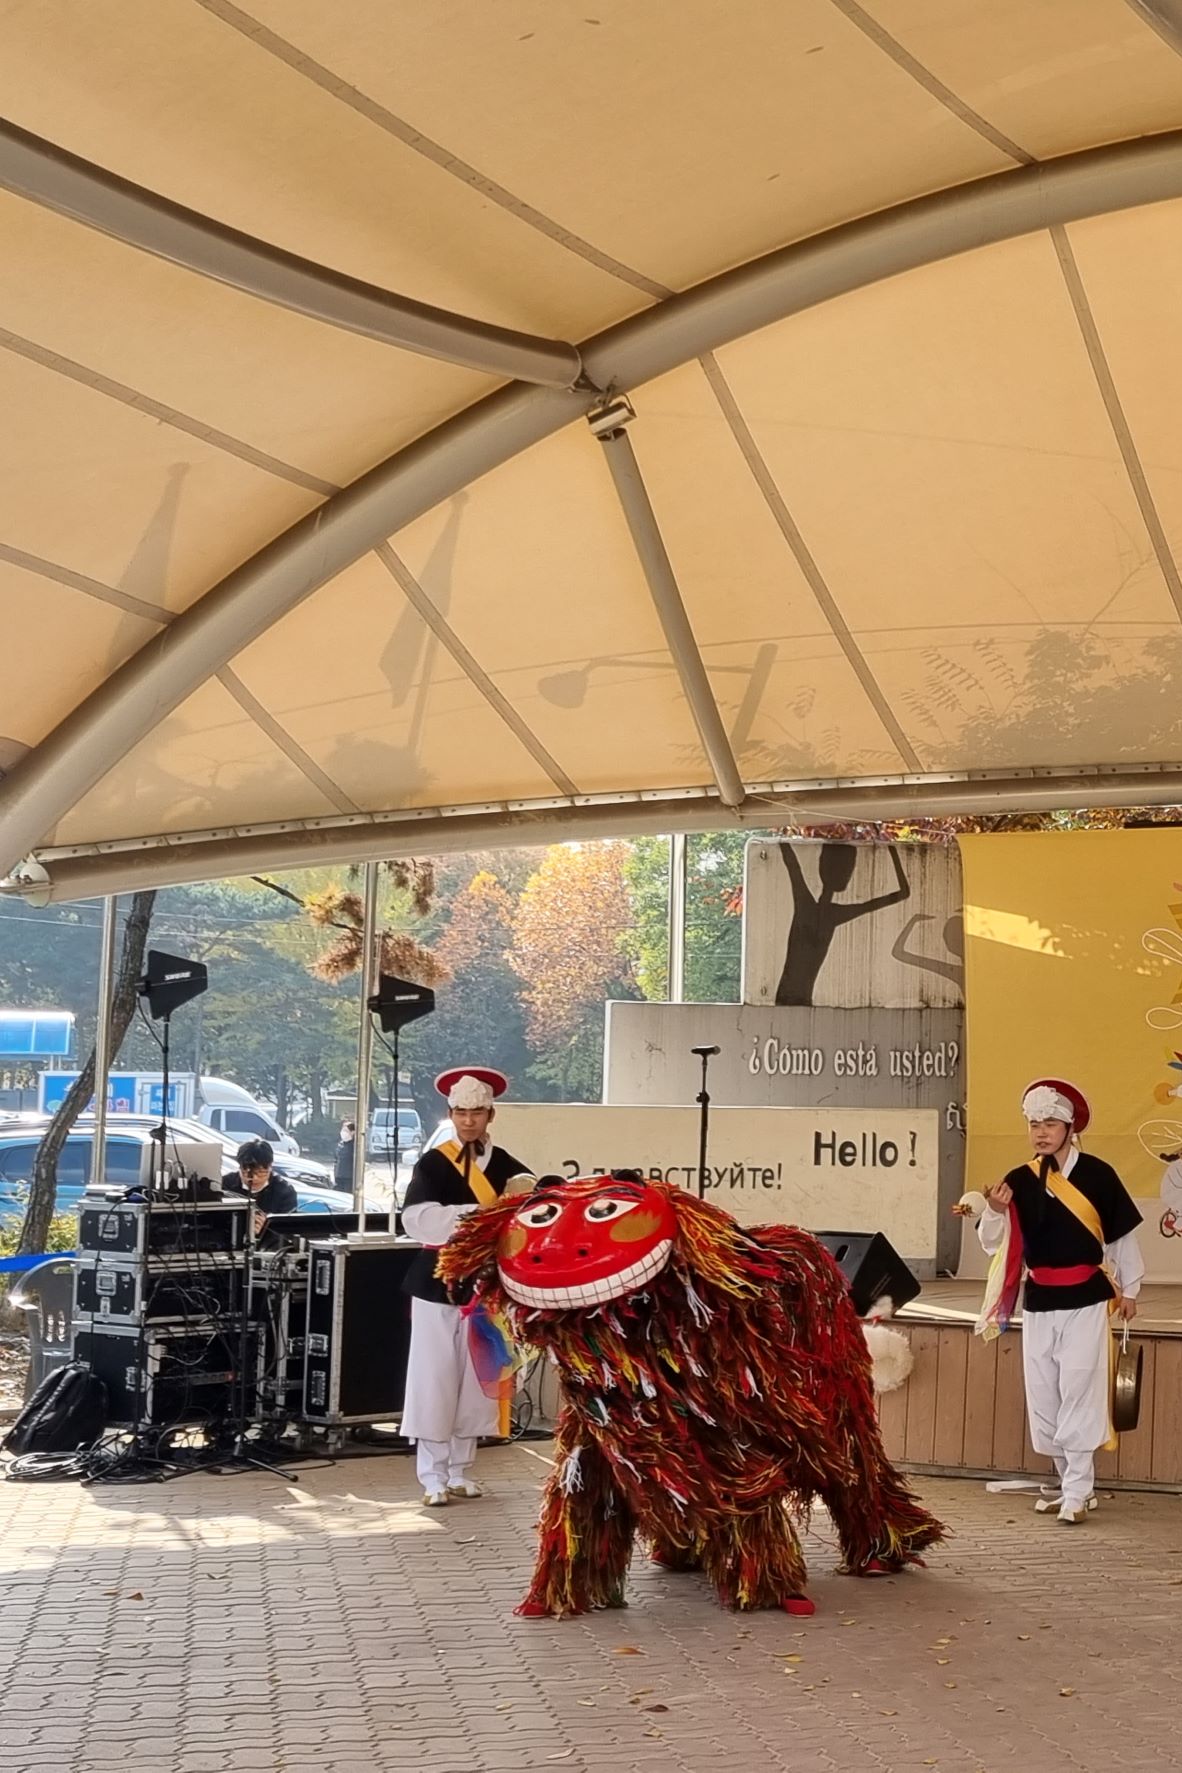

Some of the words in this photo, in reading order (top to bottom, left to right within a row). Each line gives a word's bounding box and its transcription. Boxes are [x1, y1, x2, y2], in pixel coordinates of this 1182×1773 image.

[749, 1036, 823, 1076] ¿Cómo
[834, 1041, 878, 1076] está
[890, 1041, 959, 1076] usted?
